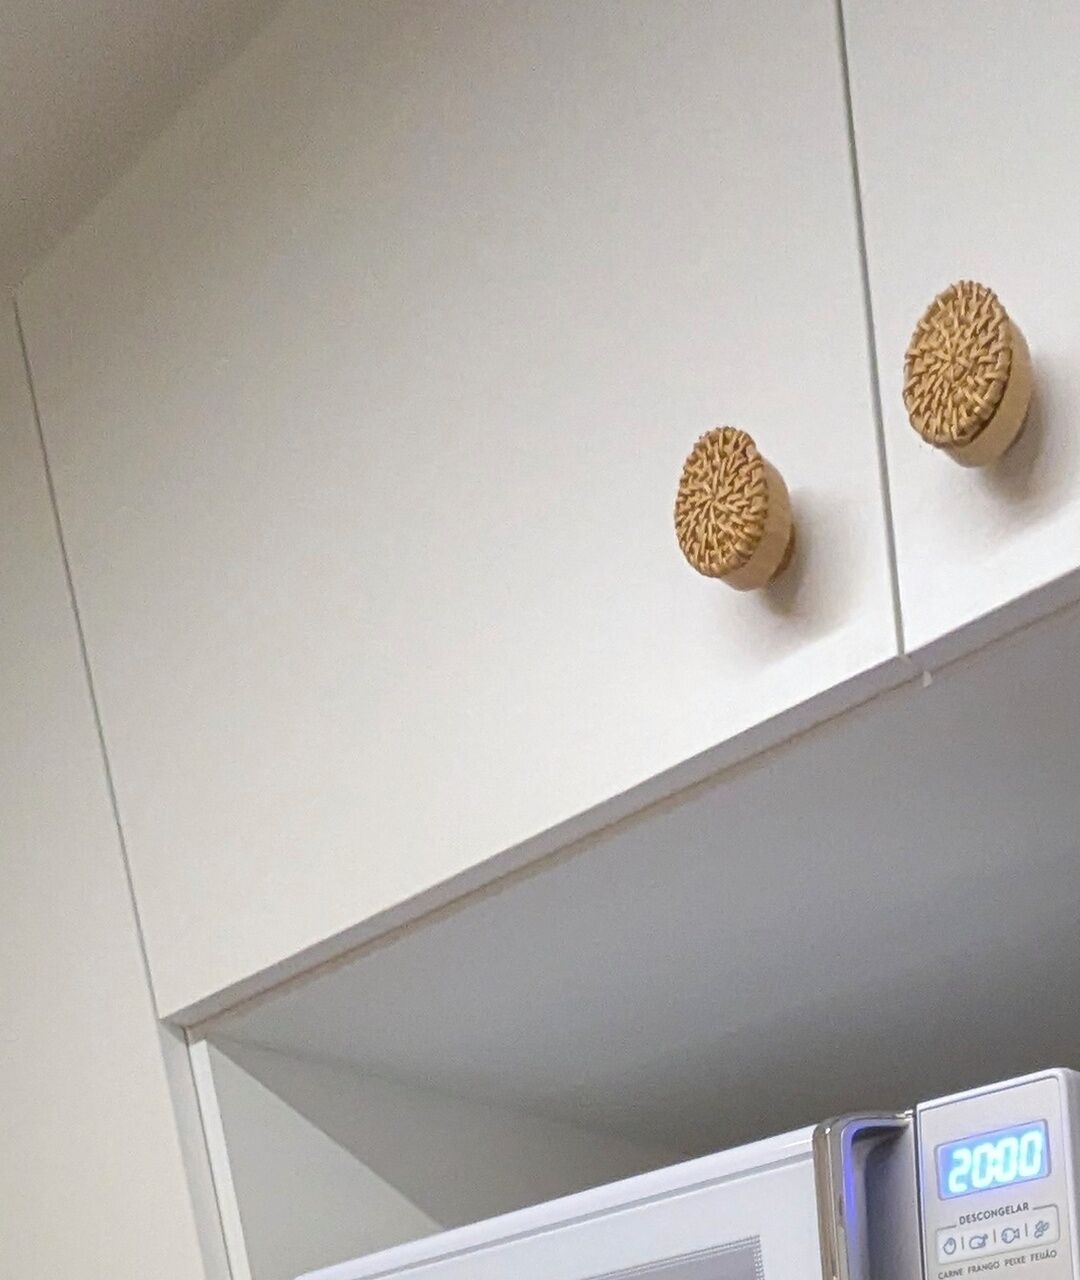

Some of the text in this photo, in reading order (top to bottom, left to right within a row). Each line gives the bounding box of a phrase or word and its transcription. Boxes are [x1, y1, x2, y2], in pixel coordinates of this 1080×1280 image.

[959, 1202, 1029, 1225] DESCONGELAR
[938, 1268, 963, 1280] CARNE
[967, 1261, 1000, 1274] FRANGO
[1004, 1255, 1026, 1266] PEIXE
